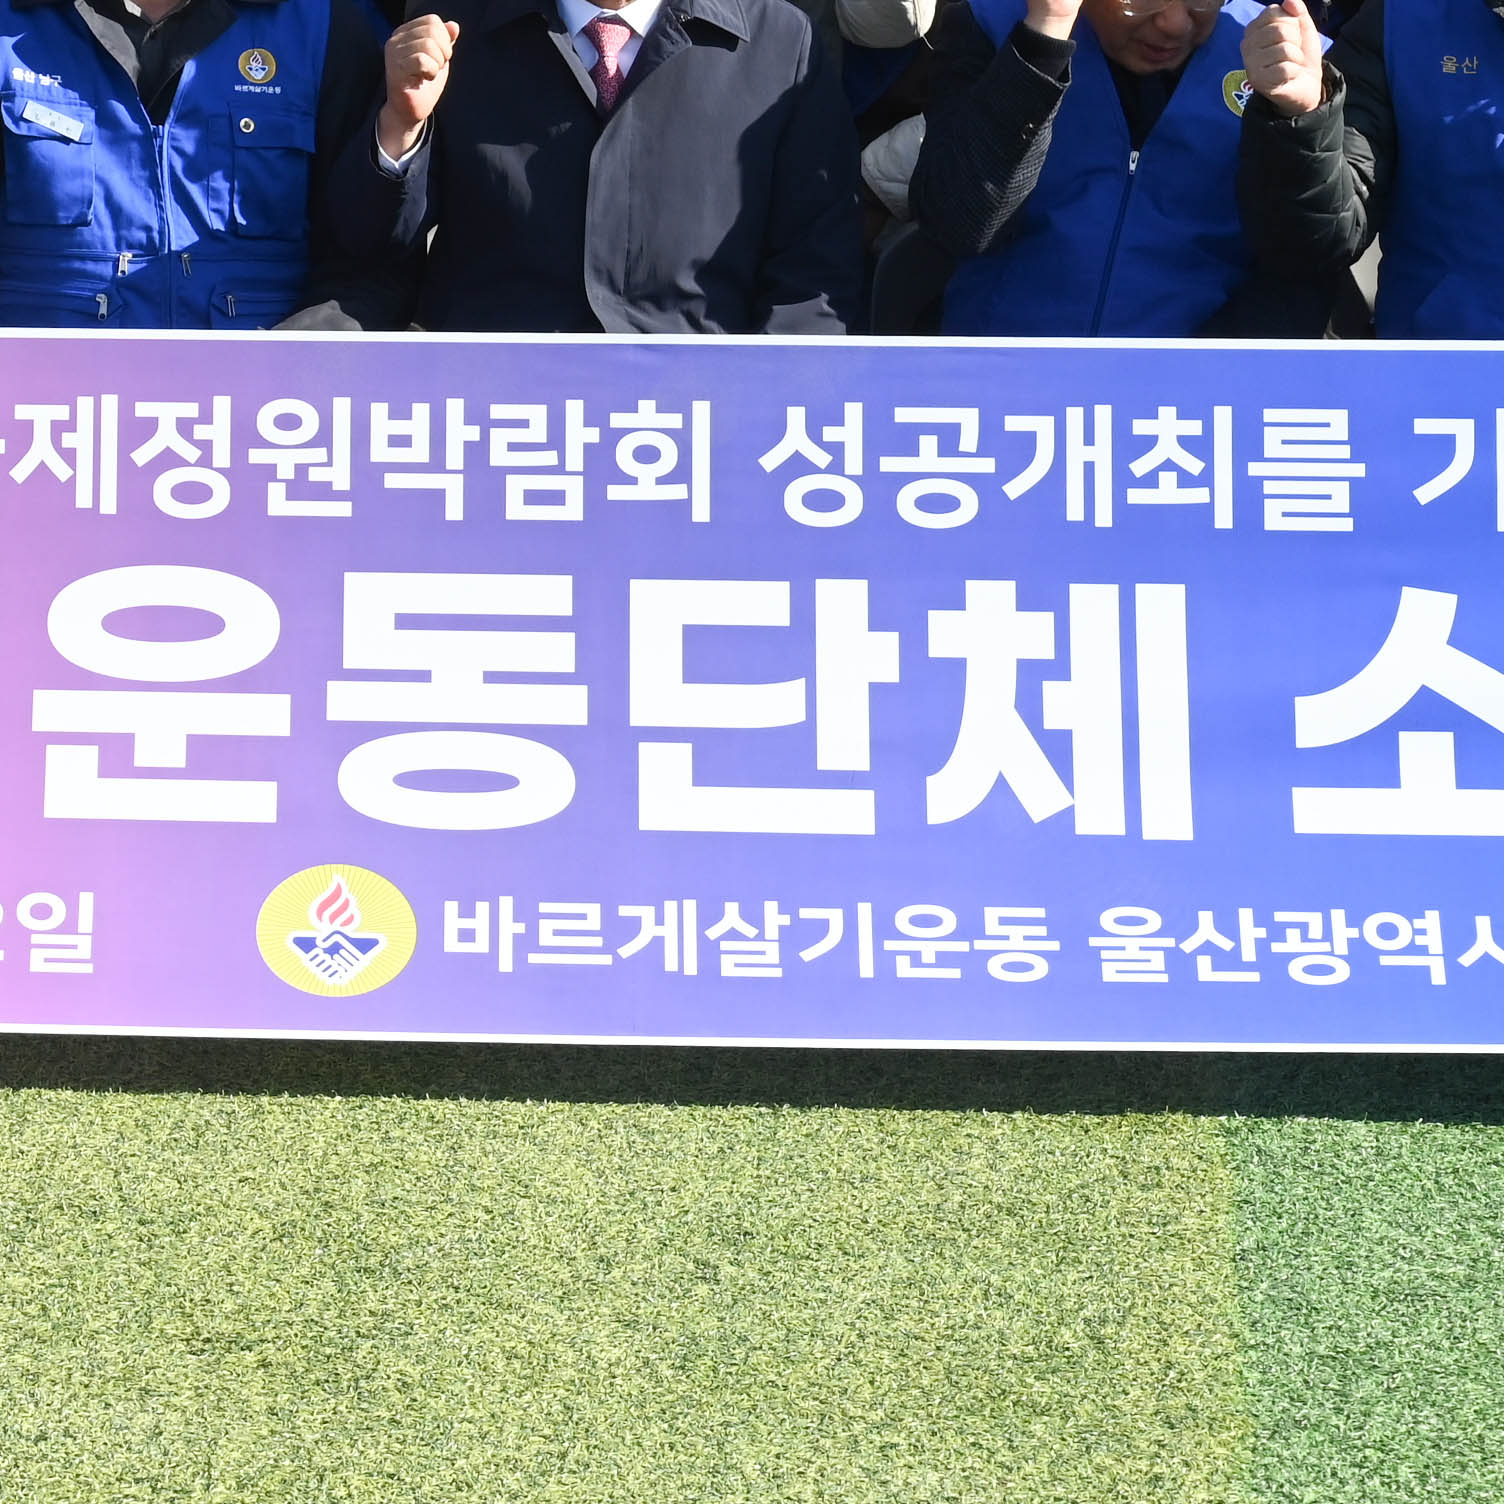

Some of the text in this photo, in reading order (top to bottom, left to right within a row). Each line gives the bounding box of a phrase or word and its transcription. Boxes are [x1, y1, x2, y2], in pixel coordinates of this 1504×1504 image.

[1440, 55, 1479, 74] 울산
[757, 401, 1366, 533] 성공개최를
[1291, 585, 1504, 838] 소
[442, 894, 1061, 984] 바르게살기운동
